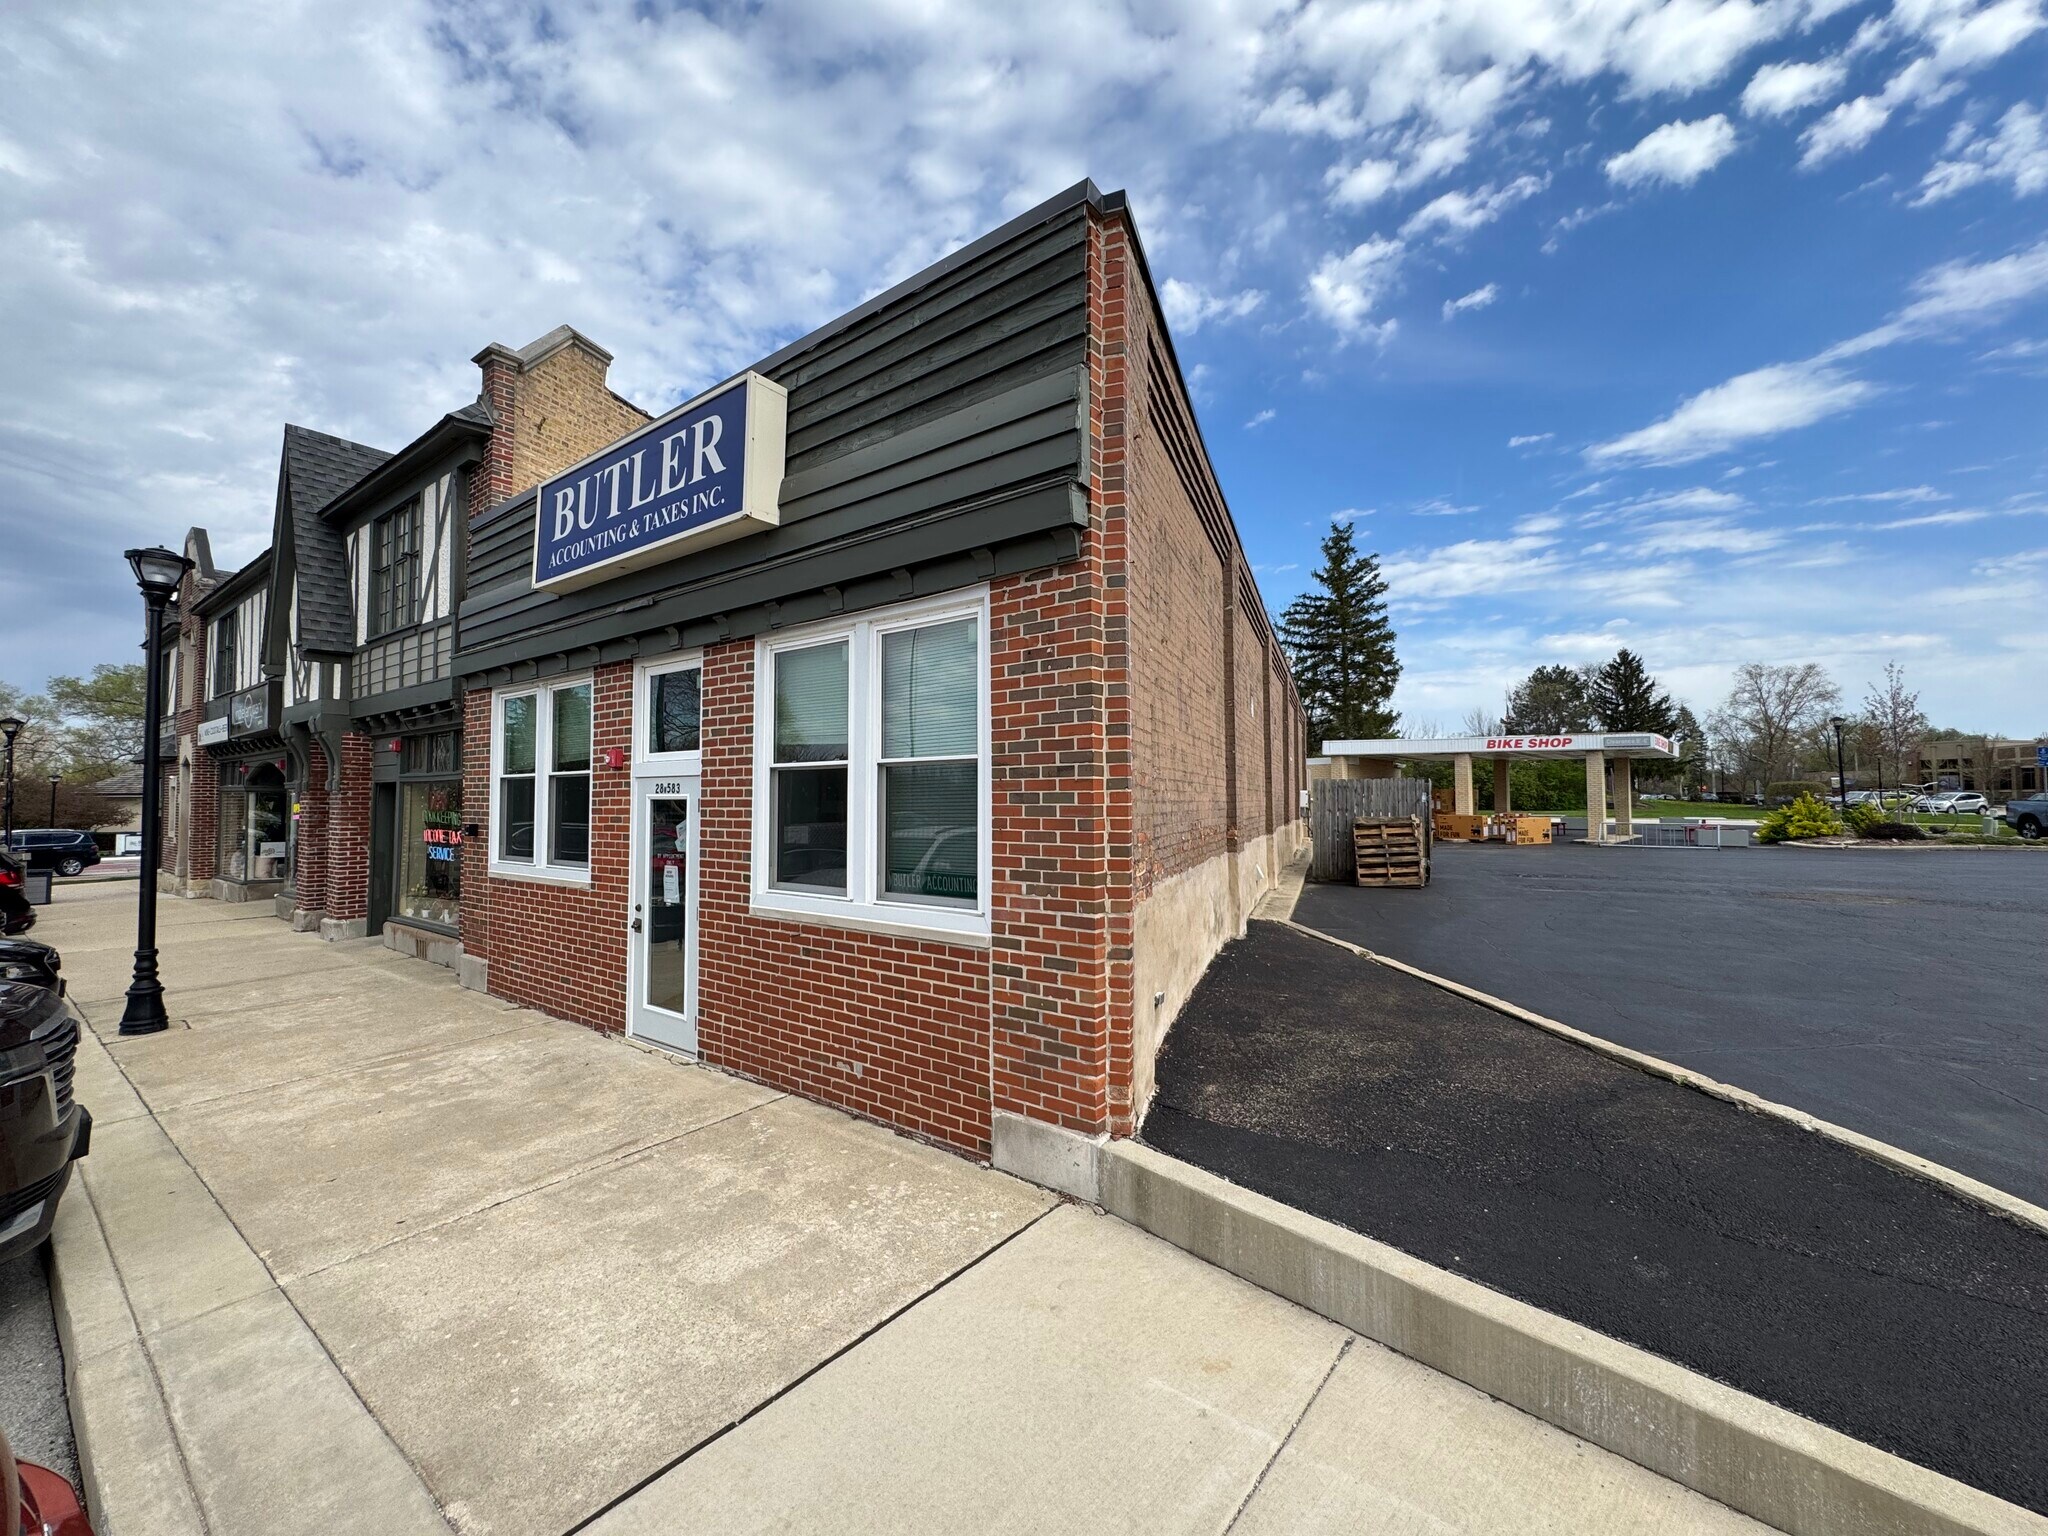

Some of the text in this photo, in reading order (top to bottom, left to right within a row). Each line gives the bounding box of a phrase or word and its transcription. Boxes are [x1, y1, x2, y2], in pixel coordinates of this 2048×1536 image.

[551, 414, 727, 543] BUTLER
[548, 485, 725, 569] ACCOUNTING & TAXES INC.
[1486, 738, 1573, 749] BIKE SHOP
[423, 829, 462, 844] INCOME TAX
[428, 846, 455, 861] SERVICE
[893, 873, 921, 888] BUTLER
